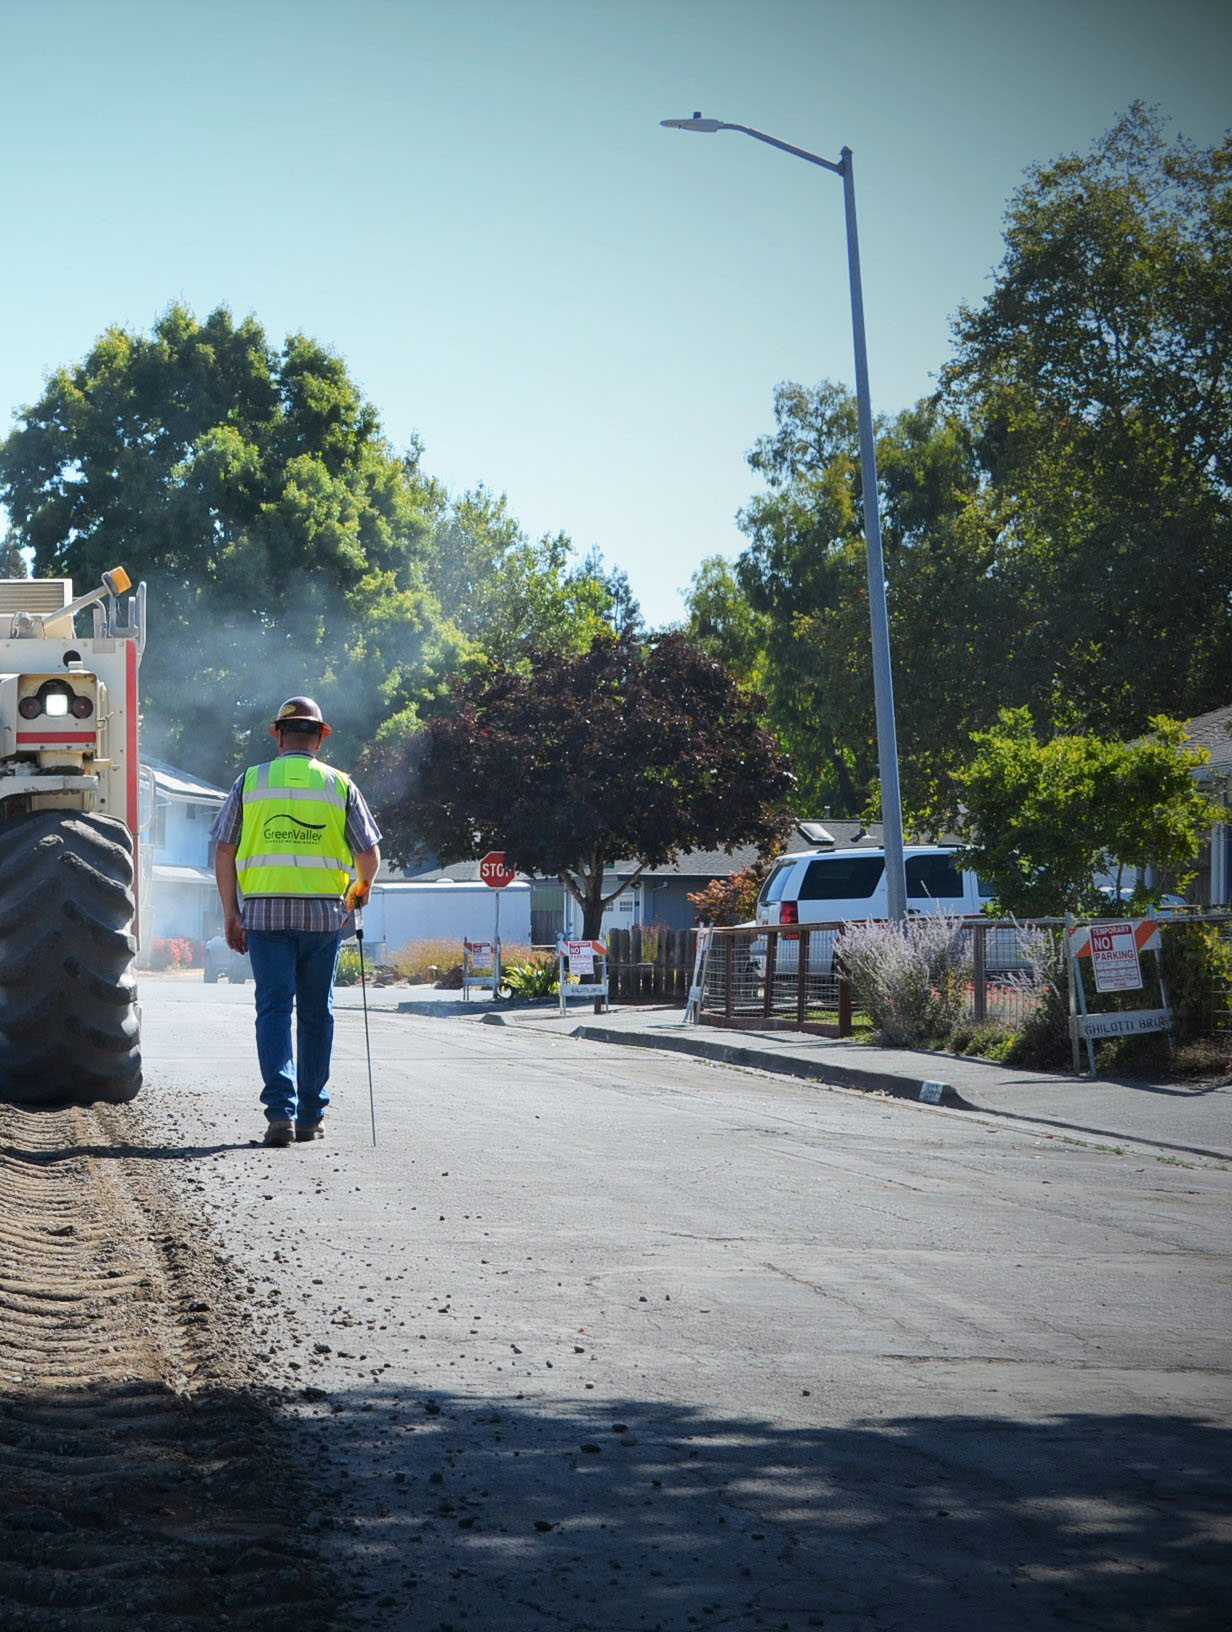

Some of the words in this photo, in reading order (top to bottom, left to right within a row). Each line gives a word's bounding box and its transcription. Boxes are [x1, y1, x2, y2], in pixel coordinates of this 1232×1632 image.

[482, 862, 509, 877] STO
[1093, 926, 1129, 935] TEMPORARY
[1094, 937, 1110, 950] NO
[1095, 950, 1134, 961] PARKING
[1086, 1020, 1134, 1034] GHILOTTI
